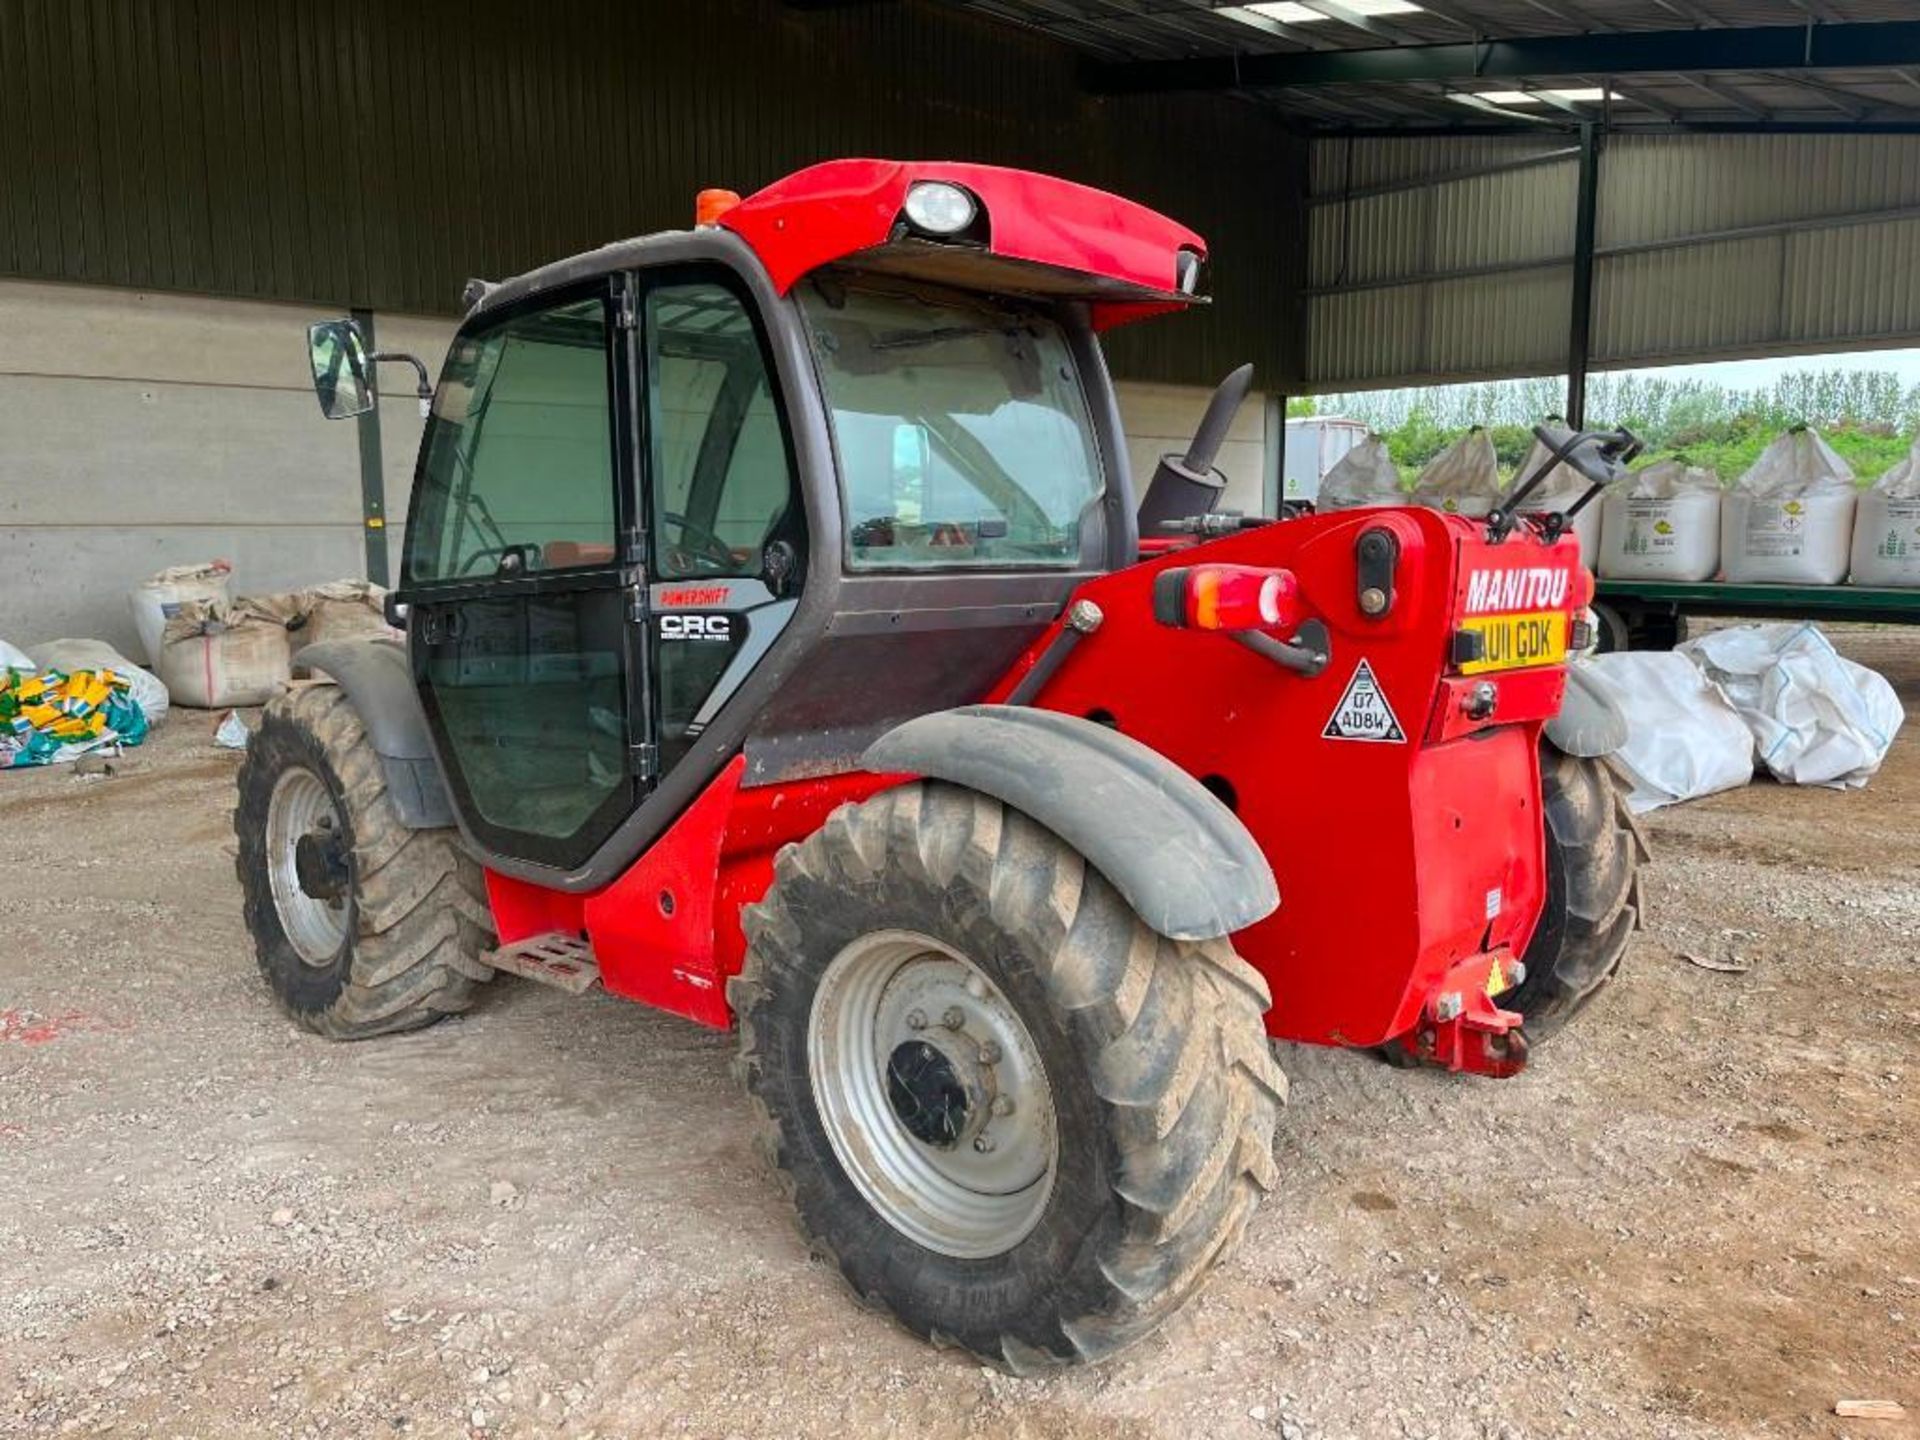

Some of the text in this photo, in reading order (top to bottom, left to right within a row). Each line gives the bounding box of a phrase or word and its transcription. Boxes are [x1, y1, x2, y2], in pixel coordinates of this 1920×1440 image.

[659, 587, 730, 606] POWERSHIFT
[1465, 568, 1569, 612] MANITOU
[660, 615, 730, 634] CRC
[1516, 619, 1552, 659] GDK
